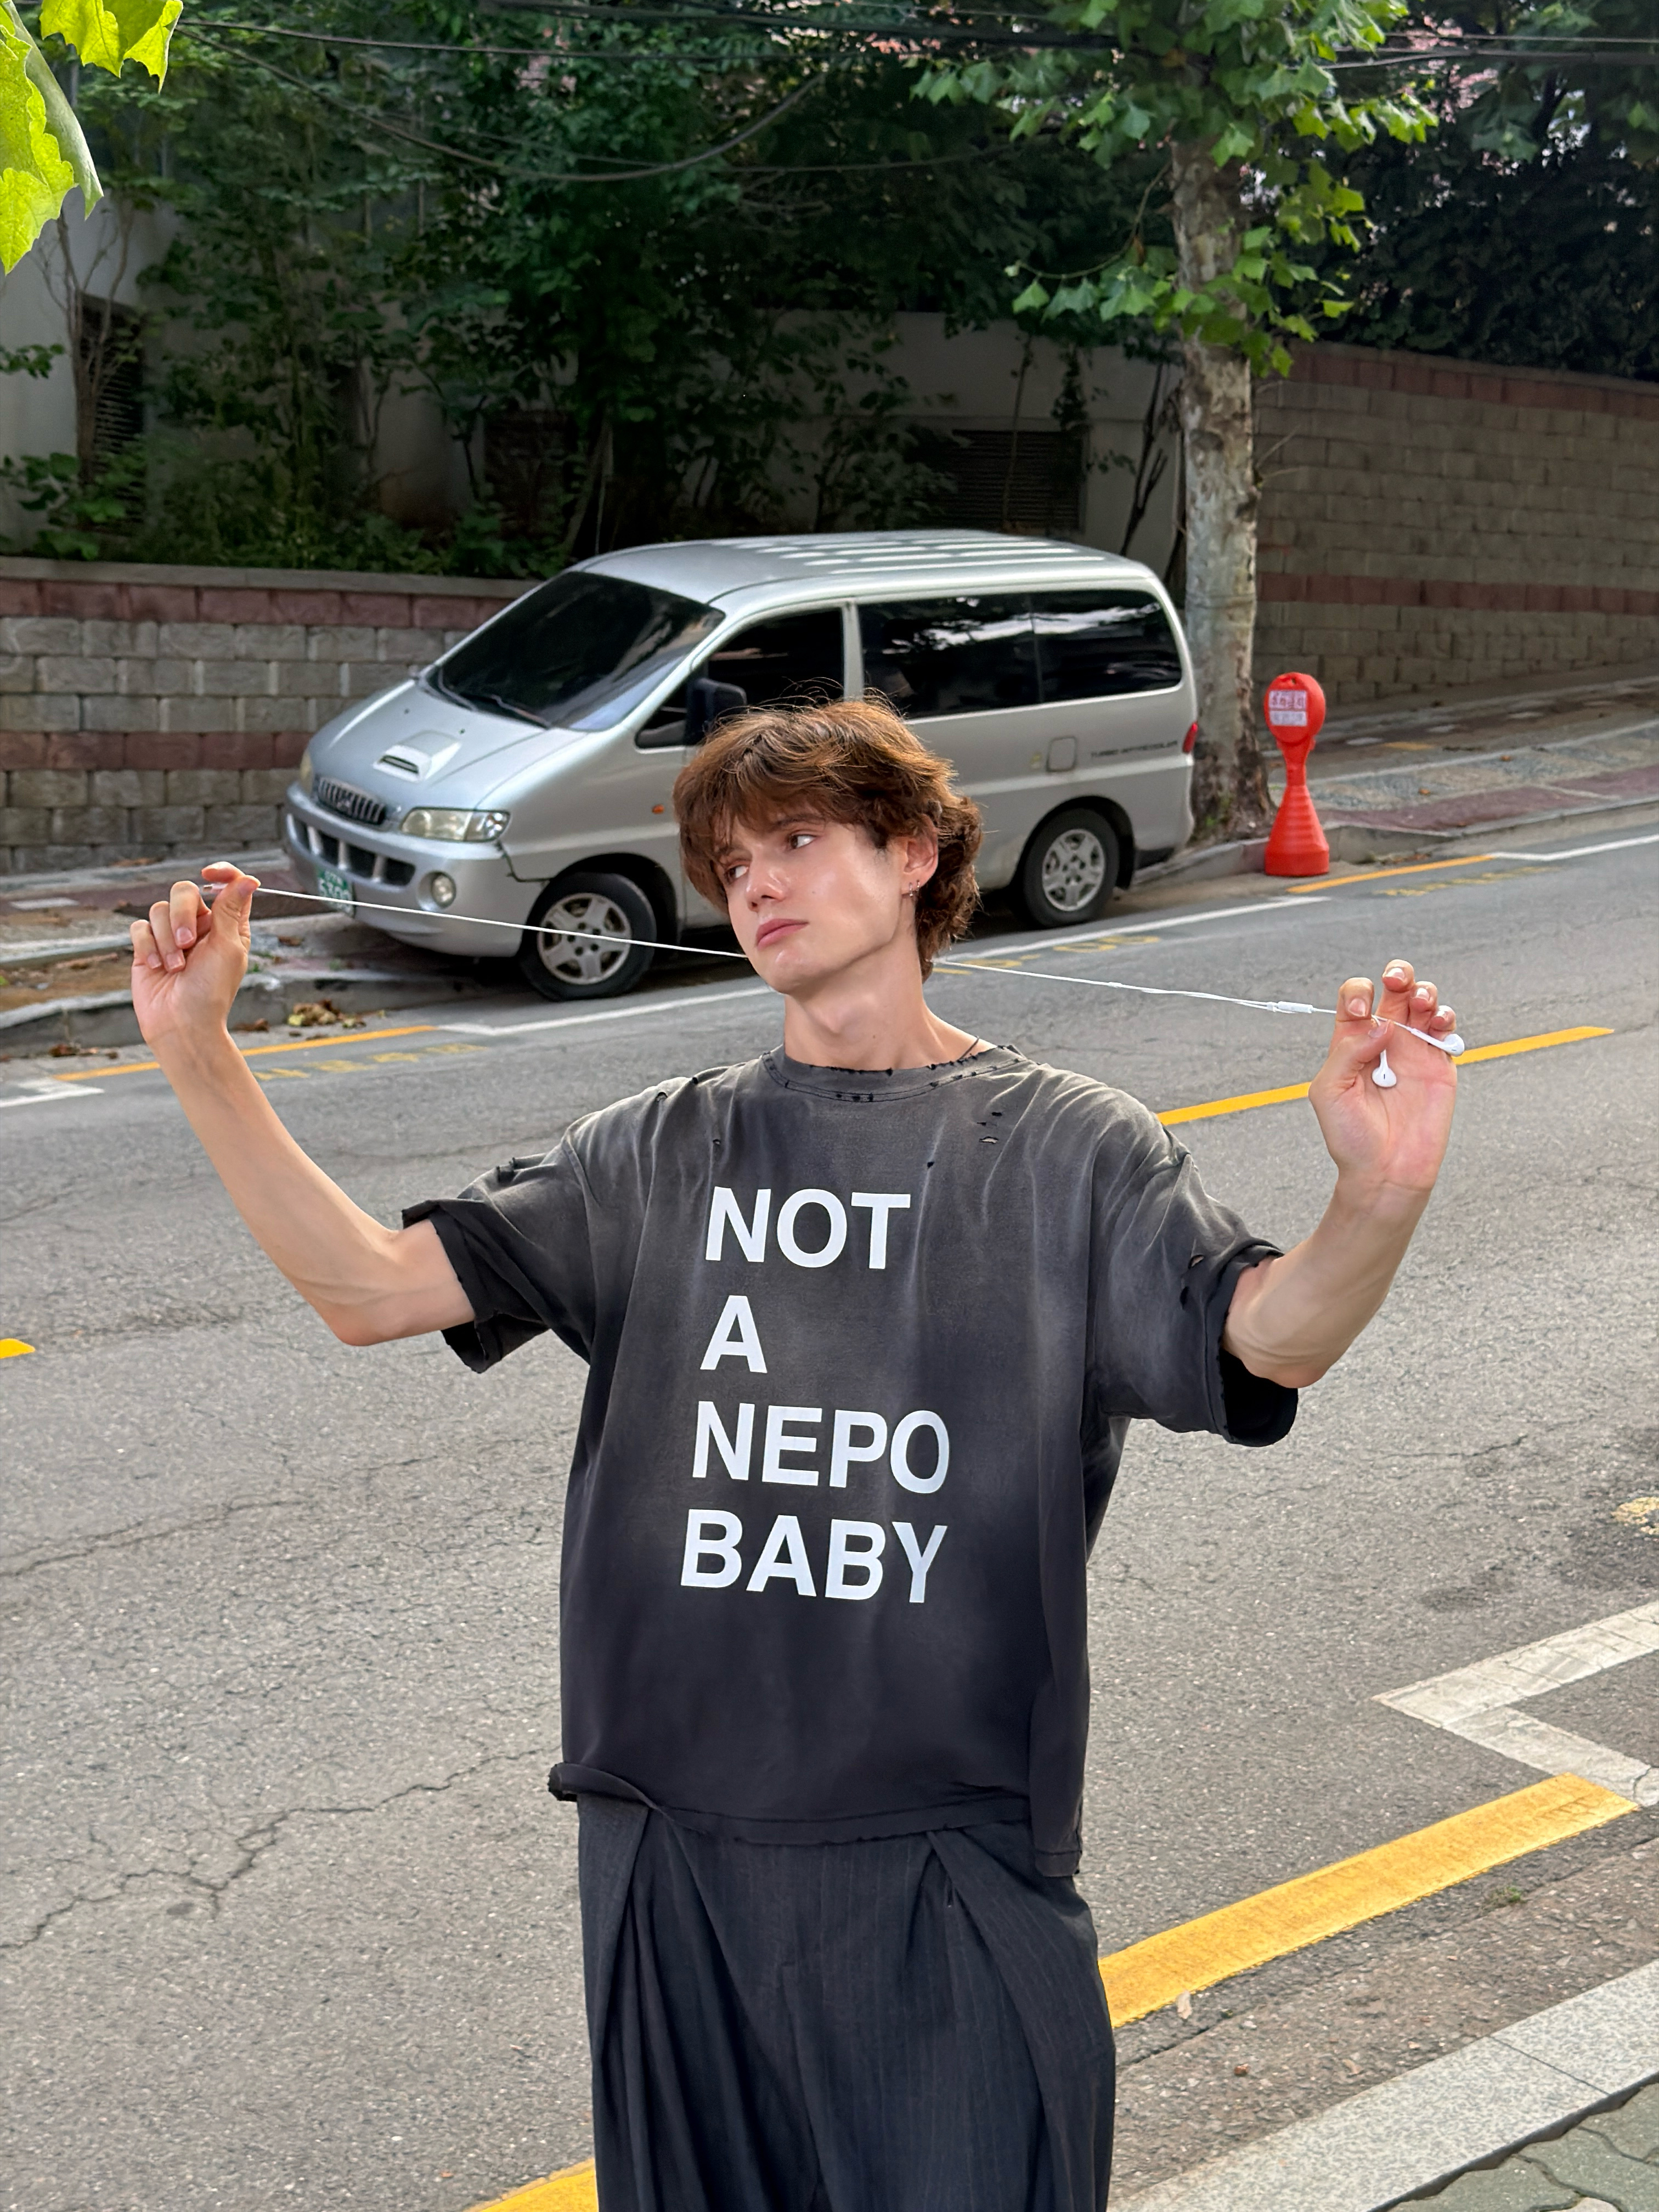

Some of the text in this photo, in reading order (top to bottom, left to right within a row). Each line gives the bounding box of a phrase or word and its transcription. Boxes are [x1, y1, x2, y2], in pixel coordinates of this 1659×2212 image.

[705, 1186, 911, 1269] NOT
[699, 1295, 768, 1374] A
[692, 1401, 950, 1494] NEPO
[680, 1509, 948, 1604] BABY
